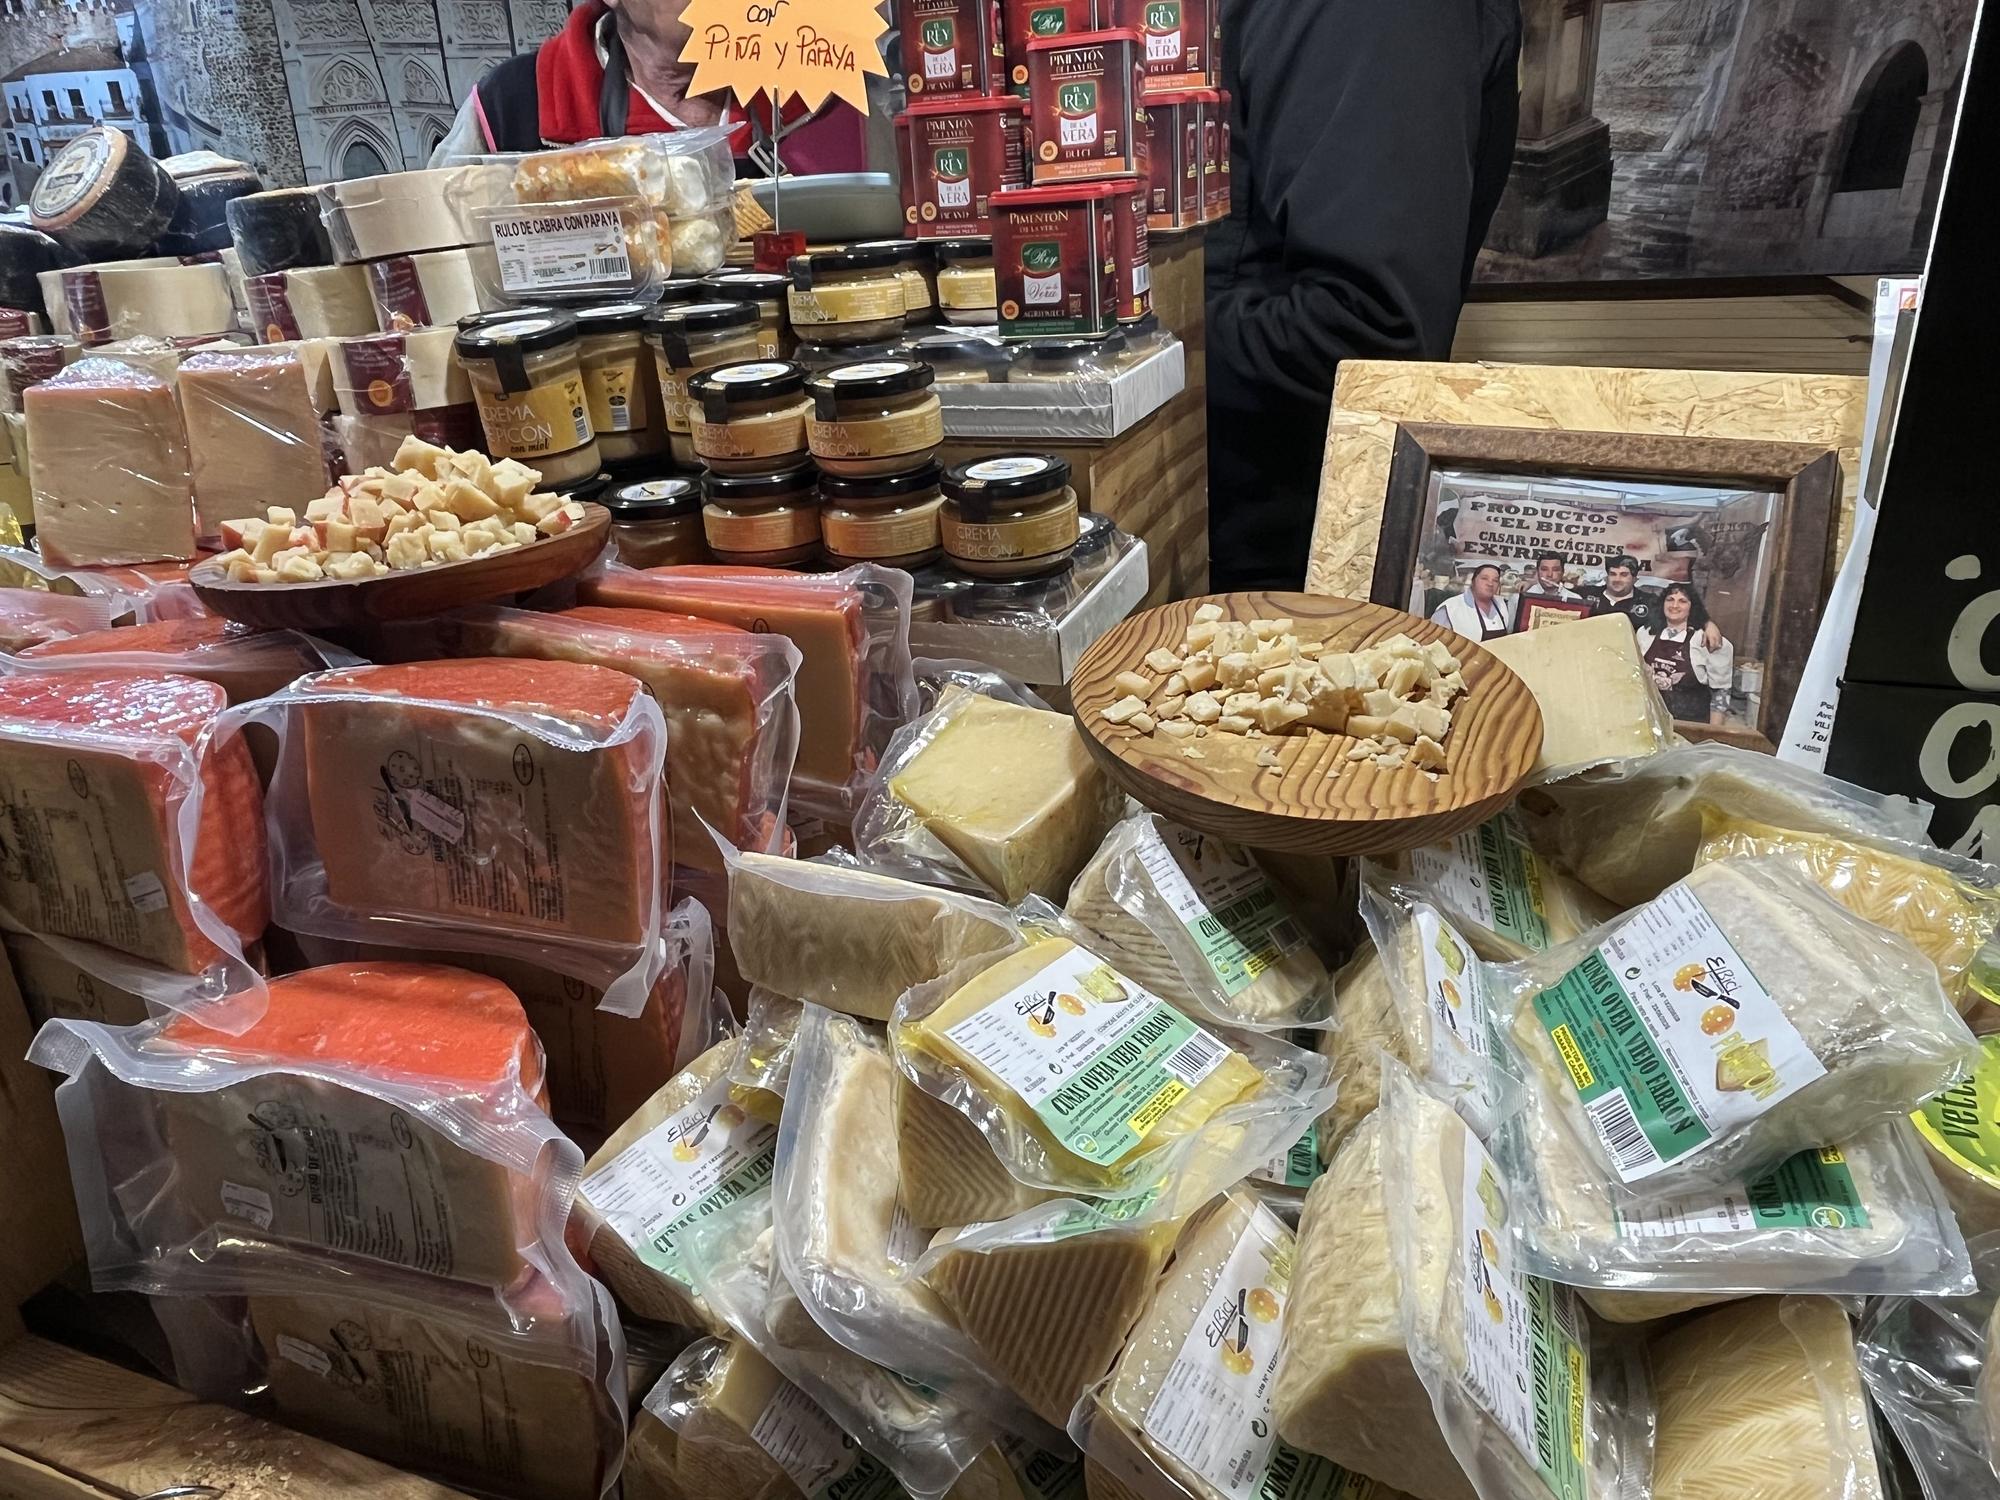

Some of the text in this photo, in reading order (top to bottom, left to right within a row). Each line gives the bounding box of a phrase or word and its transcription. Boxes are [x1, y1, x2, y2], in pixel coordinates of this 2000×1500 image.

[1150, 12, 1176, 29] REY
[796, 25, 855, 72] PAPAYA
[1148, 44, 1178, 57] VERA
[926, 62, 954, 76] VERA
[1064, 92, 1092, 111] REY
[1062, 128, 1095, 142] VERA
[940, 158, 963, 176] REY
[940, 192, 969, 204] VERA
[495, 211, 619, 238] RULO DE CABRA CON PAPAYA
[483, 404, 535, 422] CREMA
[812, 424, 848, 439] CREMA
[1470, 501, 1619, 525] PRODUCTOS
[957, 527, 1001, 541] CREMA
[1479, 531, 1624, 556] CASAR DE CÁCERES
[1560, 1026, 1581, 1063] PRODUCTOS
[1580, 955, 1613, 995] CUÑAS
[1601, 992, 1636, 1036] OVEJA
[1625, 1031, 1660, 1075] VIEJO
[1649, 1072, 1695, 1136] FARAON
[1051, 1083, 1090, 1115] CUÑAS
[1080, 1060, 1119, 1091] OVEJA
[1106, 1040, 1142, 1068] VIEJO
[1131, 1009, 1177, 1048] FARAON
[700, 1179, 747, 1216] OVEJA
[1532, 1343, 1552, 1404] OVEJA
[1259, 1446, 1300, 1500] CUÑAS
